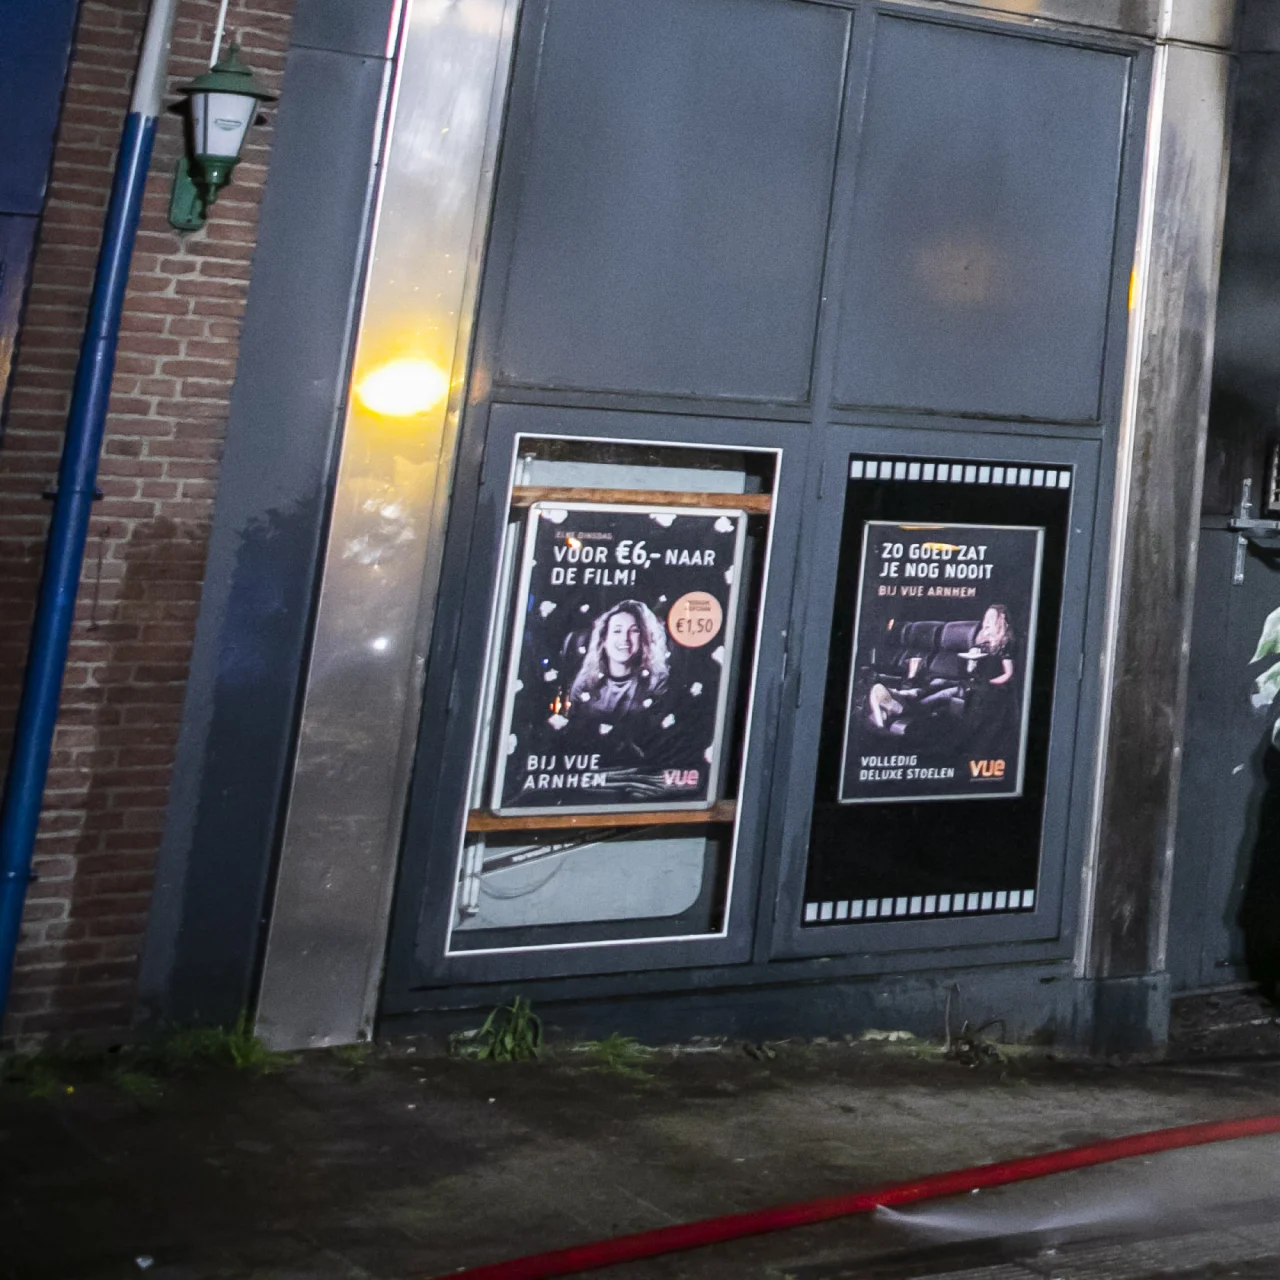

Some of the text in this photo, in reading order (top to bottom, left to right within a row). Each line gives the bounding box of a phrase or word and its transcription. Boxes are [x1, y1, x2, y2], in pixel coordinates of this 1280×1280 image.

[553, 540, 716, 569] VOOR €6,- NAAR
[881, 542, 988, 561] ZO GOED ZAT
[551, 567, 636, 586] DE FILM!
[879, 562, 994, 579] JE NOG NOOIT
[878, 585, 977, 598] BIJ VUE ARNHEM
[676, 617, 714, 636] €1,50
[527, 754, 601, 770] BIJ VUE
[861, 755, 917, 767] VOLLEDIG
[523, 772, 607, 789] ARNHEM
[859, 767, 955, 780] DELUXE STOELEN
